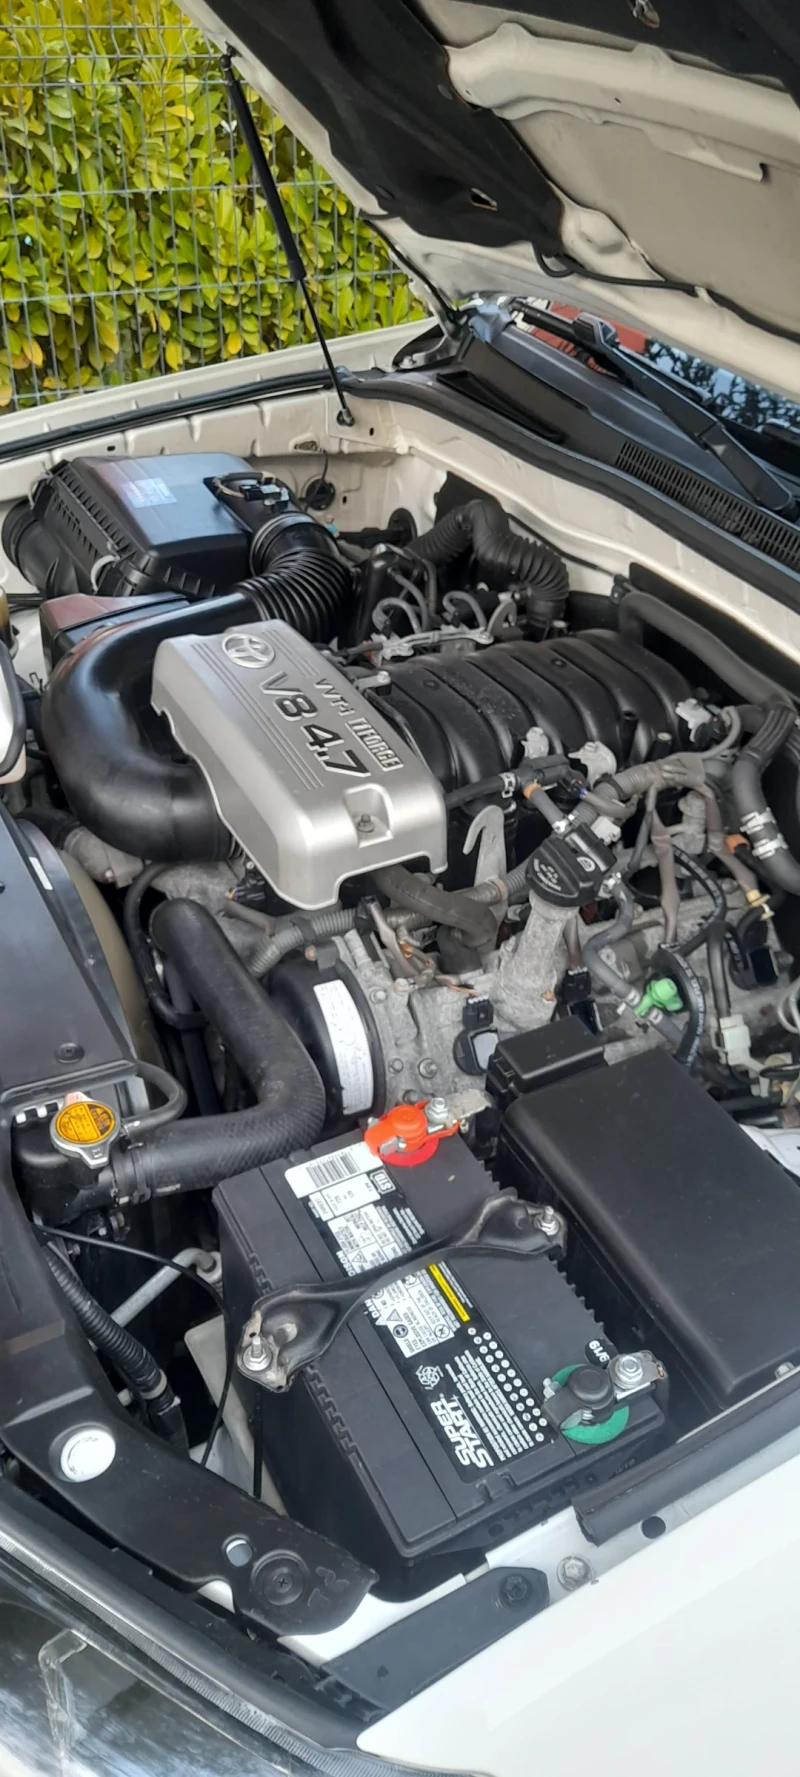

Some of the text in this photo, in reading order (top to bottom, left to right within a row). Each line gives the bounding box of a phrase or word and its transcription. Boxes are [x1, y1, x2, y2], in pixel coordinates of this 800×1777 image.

[259, 671, 371, 778] V8 4.7
[373, 1171, 393, 1193] STD
[589, 1340, 610, 1366] 9/19
[430, 1400, 472, 1465] SUPER
[440, 1397, 494, 1468] START
